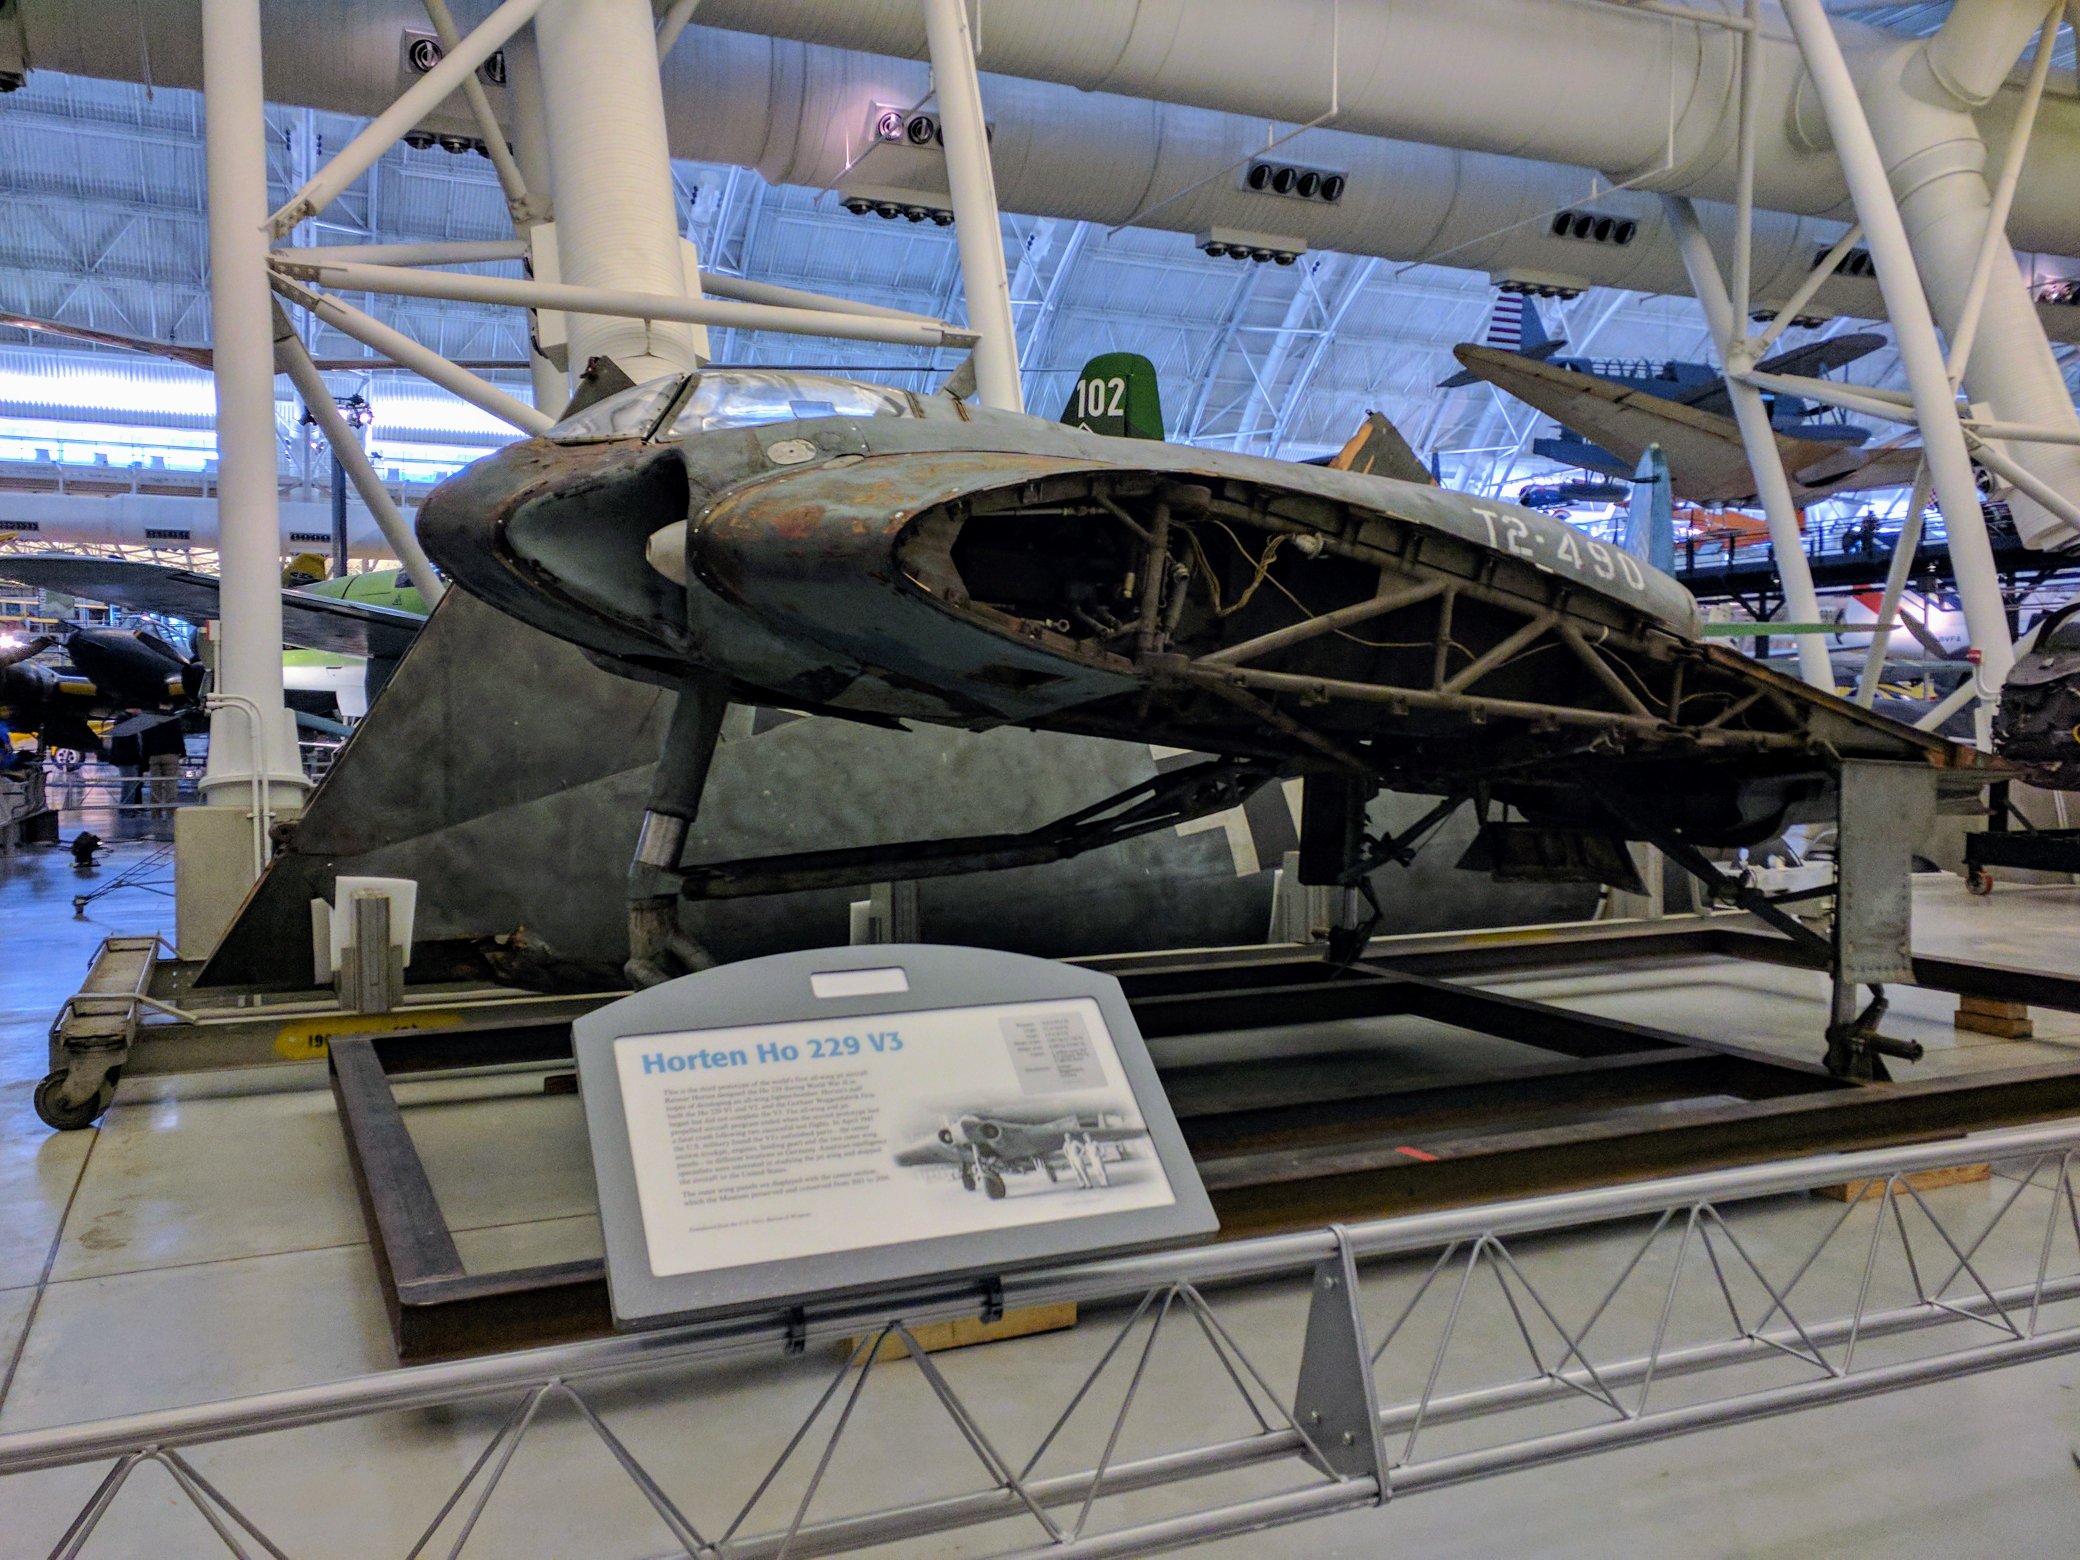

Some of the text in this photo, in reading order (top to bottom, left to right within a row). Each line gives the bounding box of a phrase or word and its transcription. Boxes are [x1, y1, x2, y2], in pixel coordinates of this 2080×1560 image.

[1077, 377, 1126, 418] 102
[641, 1031, 904, 1074] Horten Ho 229 V3
